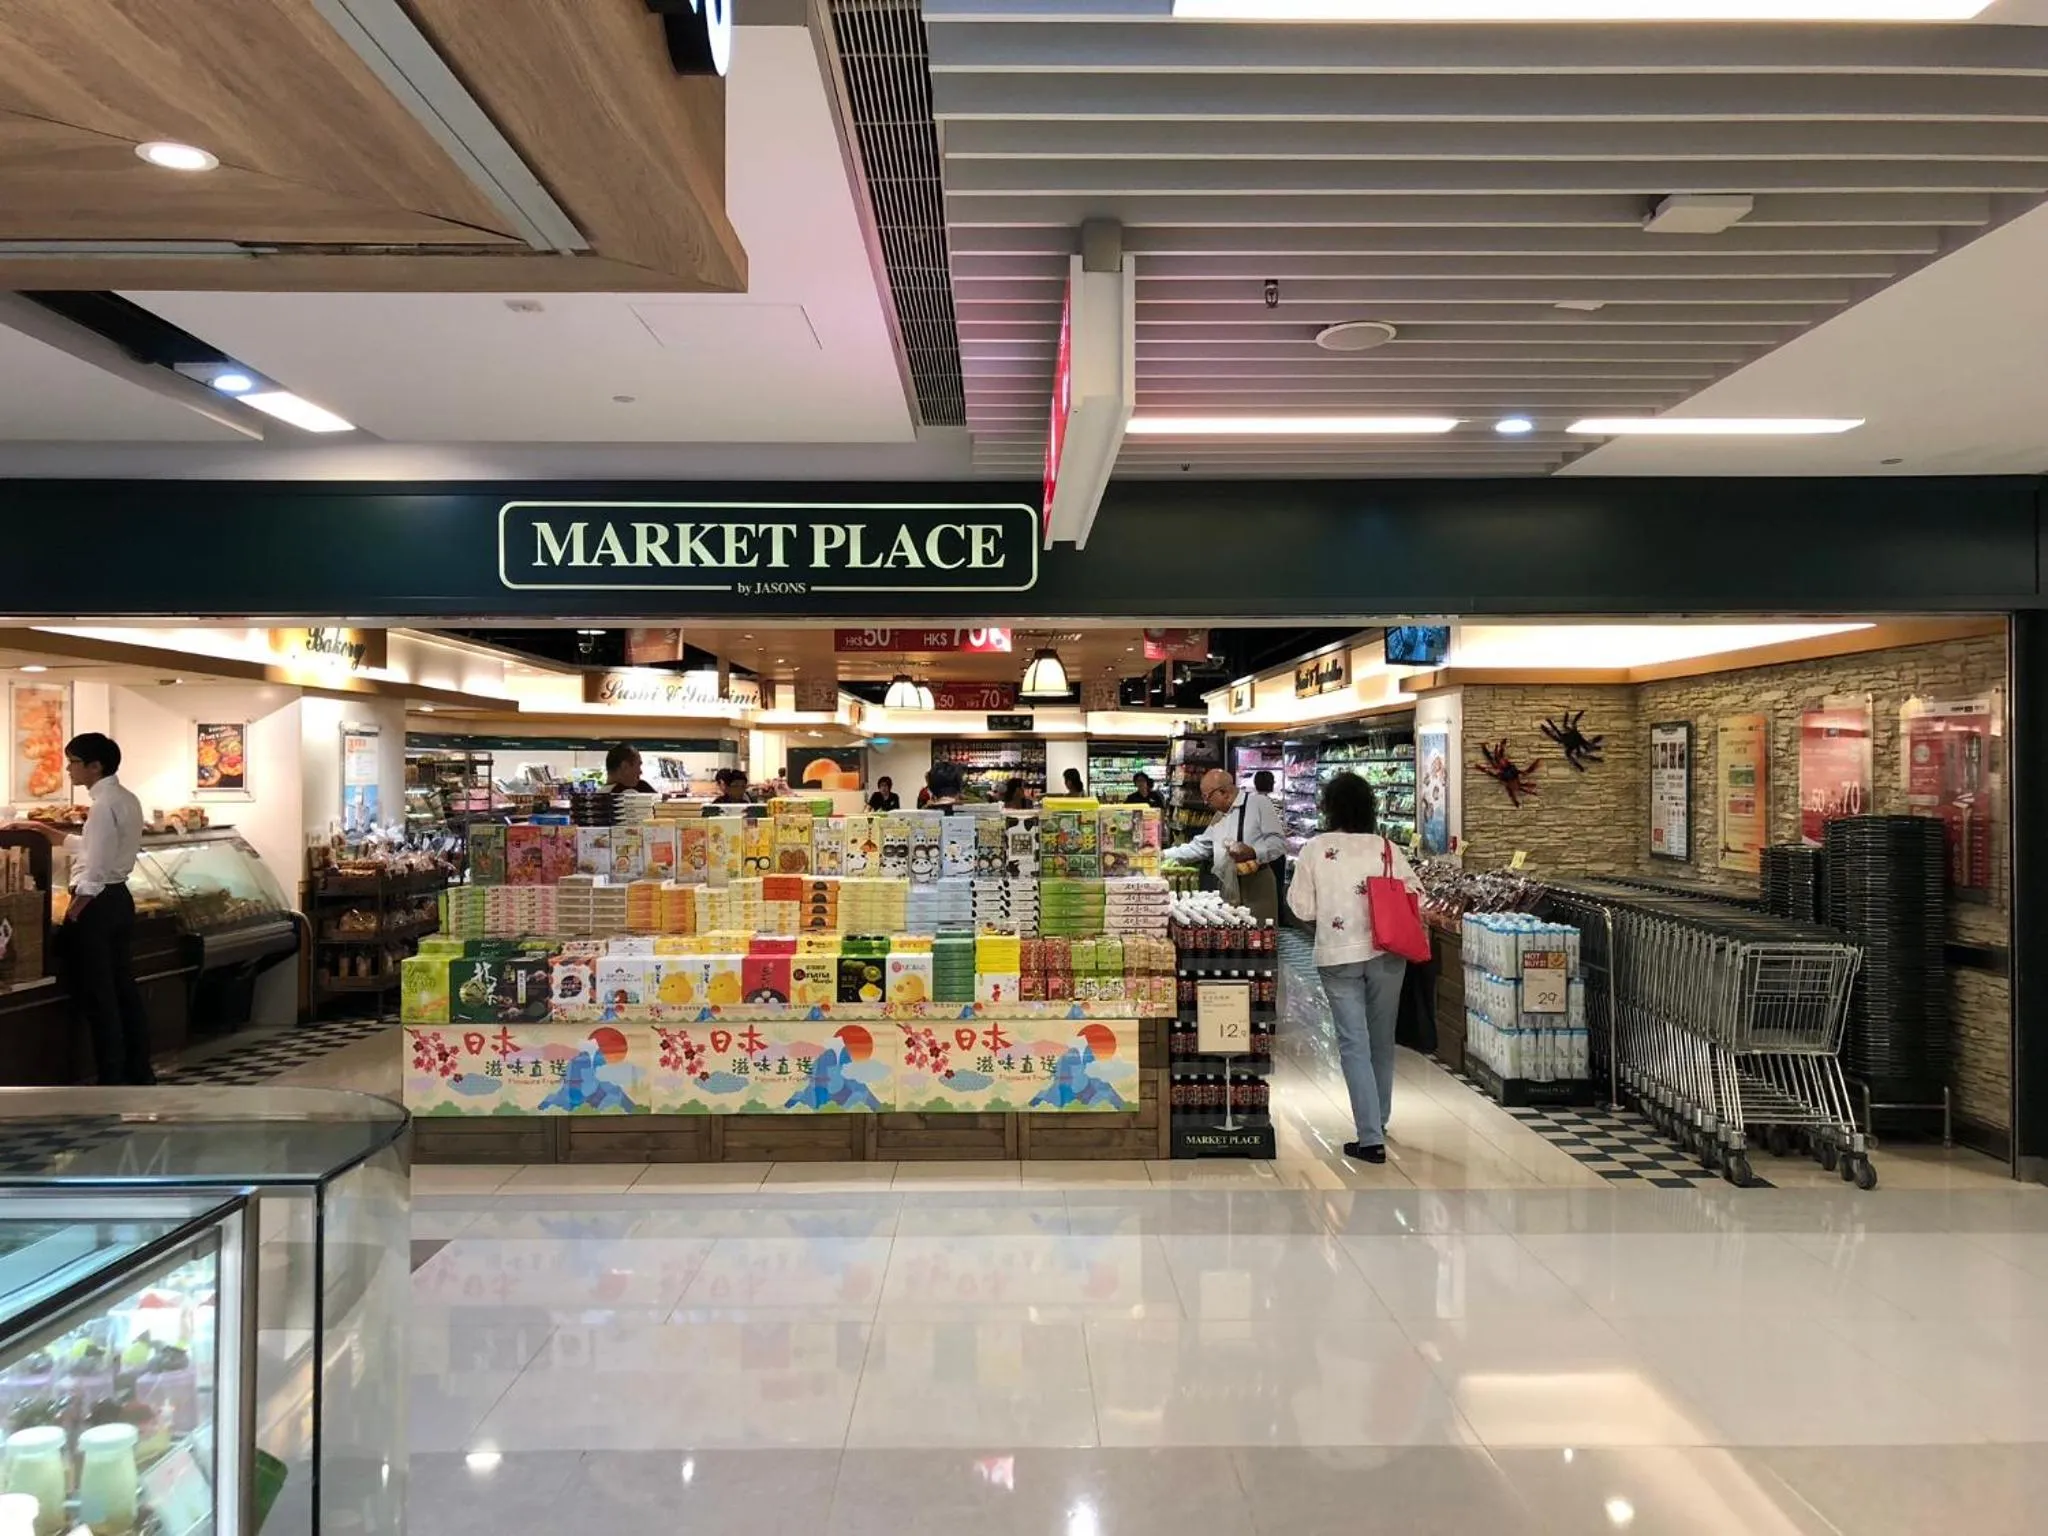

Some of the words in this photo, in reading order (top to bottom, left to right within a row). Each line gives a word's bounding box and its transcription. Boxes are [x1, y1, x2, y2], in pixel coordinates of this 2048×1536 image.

[531, 521, 797, 569] MARKET
[808, 522, 1005, 569] PLACE
[737, 582, 752, 596] by
[754, 582, 807, 595] JASONS
[600, 679, 660, 702] Sushi
[1524, 952, 1541, 960] HOT
[463, 1025, 521, 1062] 日本
[710, 1023, 768, 1060] 日本
[955, 1022, 1013, 1057] 日本
[485, 1058, 567, 1077] 滋味直送
[732, 1055, 813, 1075] 滋味直送
[976, 1053, 1057, 1074] 滋味直送
[1186, 1136, 1227, 1145] MARKET
[1229, 1136, 1261, 1145] PLACE
